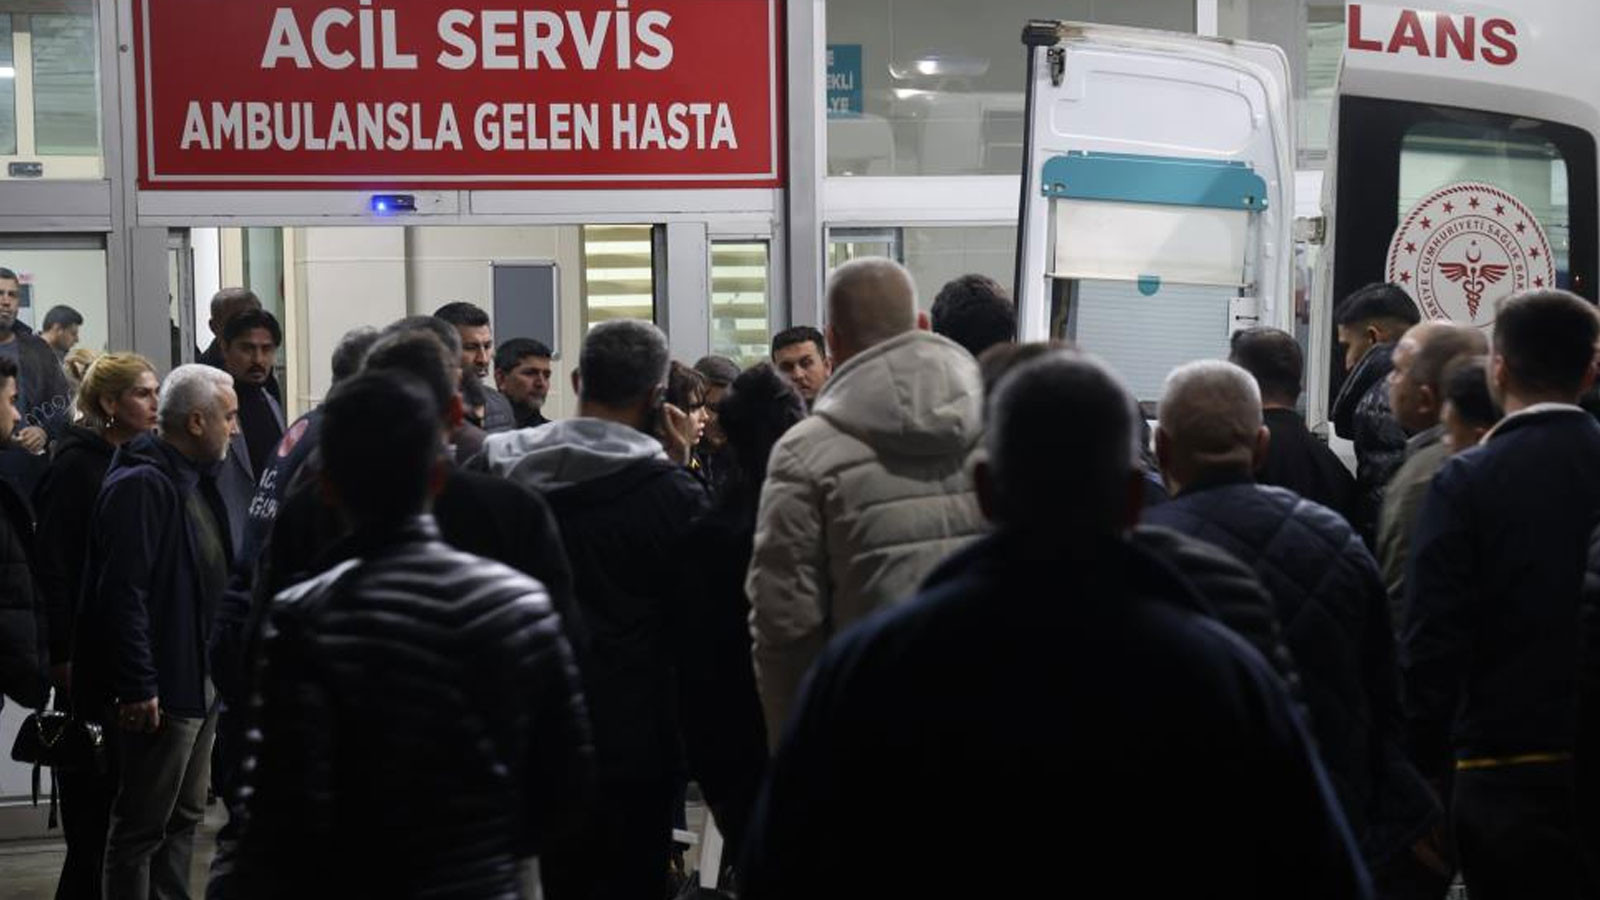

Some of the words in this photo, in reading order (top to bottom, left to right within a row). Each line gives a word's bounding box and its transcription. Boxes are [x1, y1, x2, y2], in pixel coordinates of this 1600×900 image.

[262, 0, 418, 68] ACİL
[438, 0, 673, 70] SERVİS
[1347, 4, 1518, 66] LANS
[181, 102, 462, 150] AMBULANSLA
[474, 102, 599, 150] GELEN
[612, 102, 738, 150] HASTA
